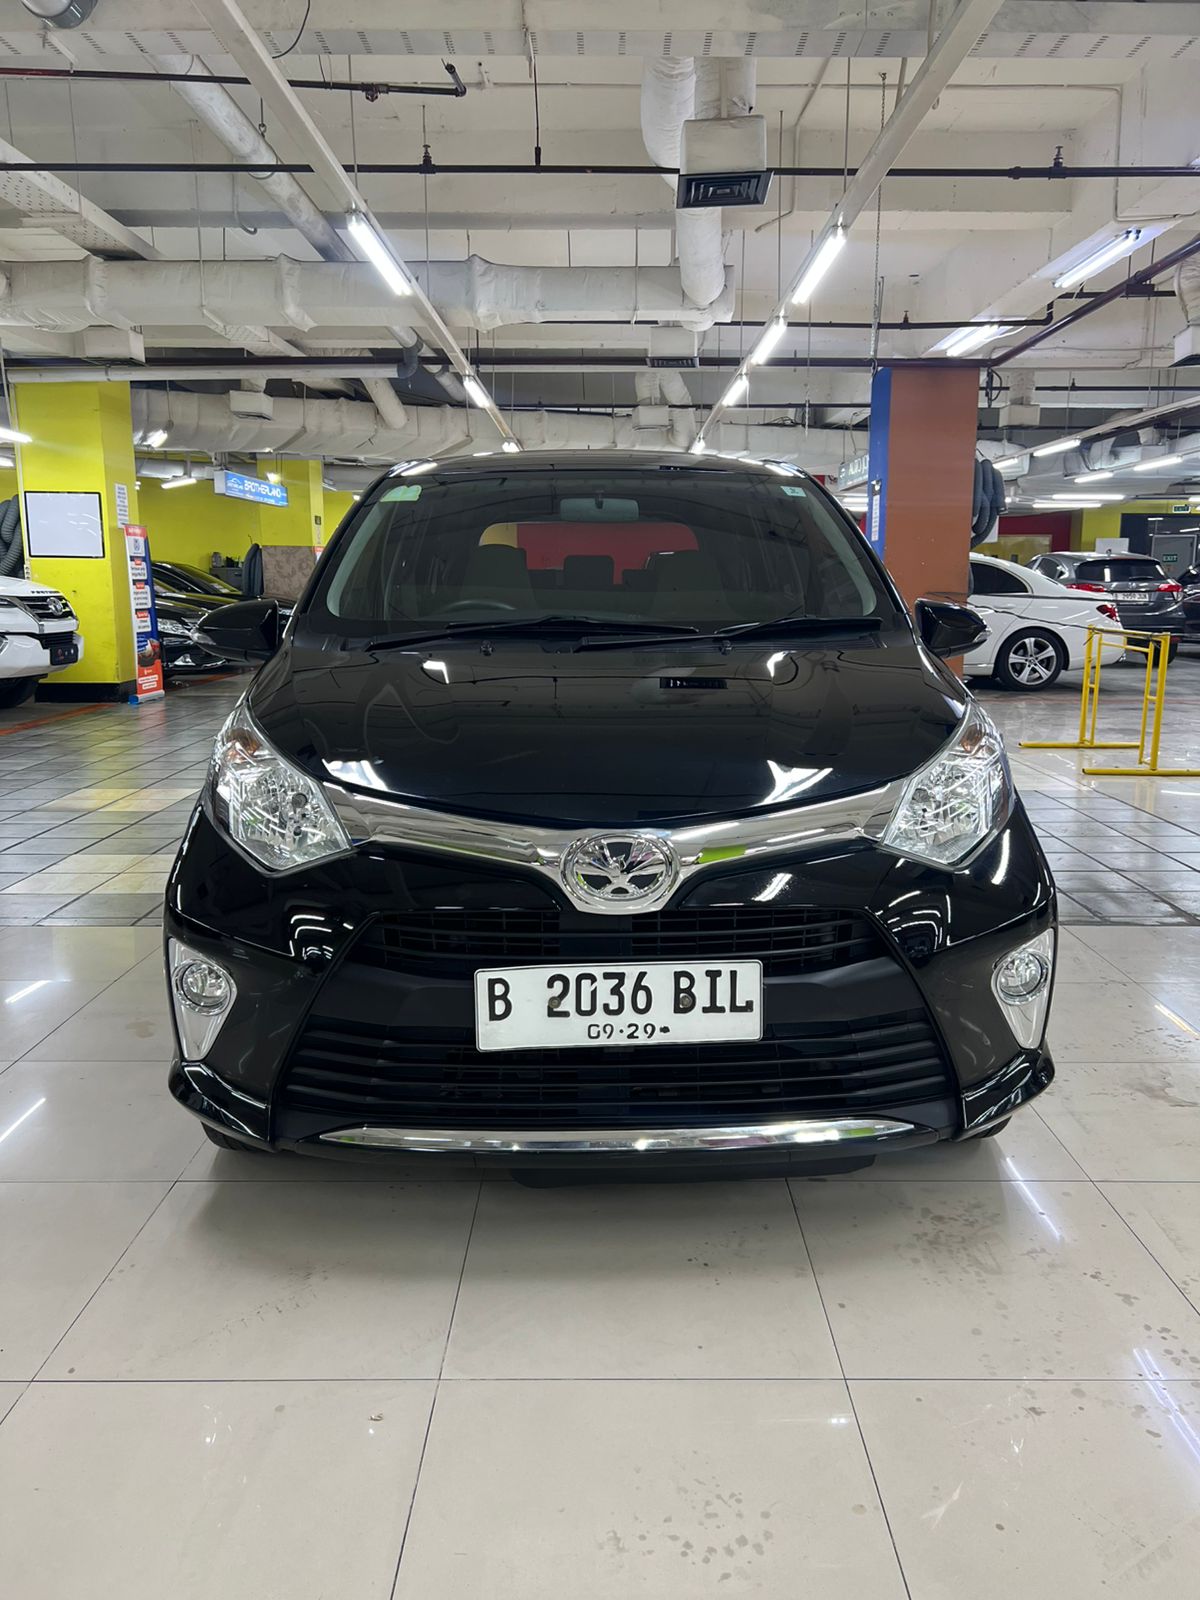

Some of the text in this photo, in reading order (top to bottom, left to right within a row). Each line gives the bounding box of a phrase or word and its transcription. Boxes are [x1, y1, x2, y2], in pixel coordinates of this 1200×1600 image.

[487, 969, 754, 1022] B 2036 BIL
